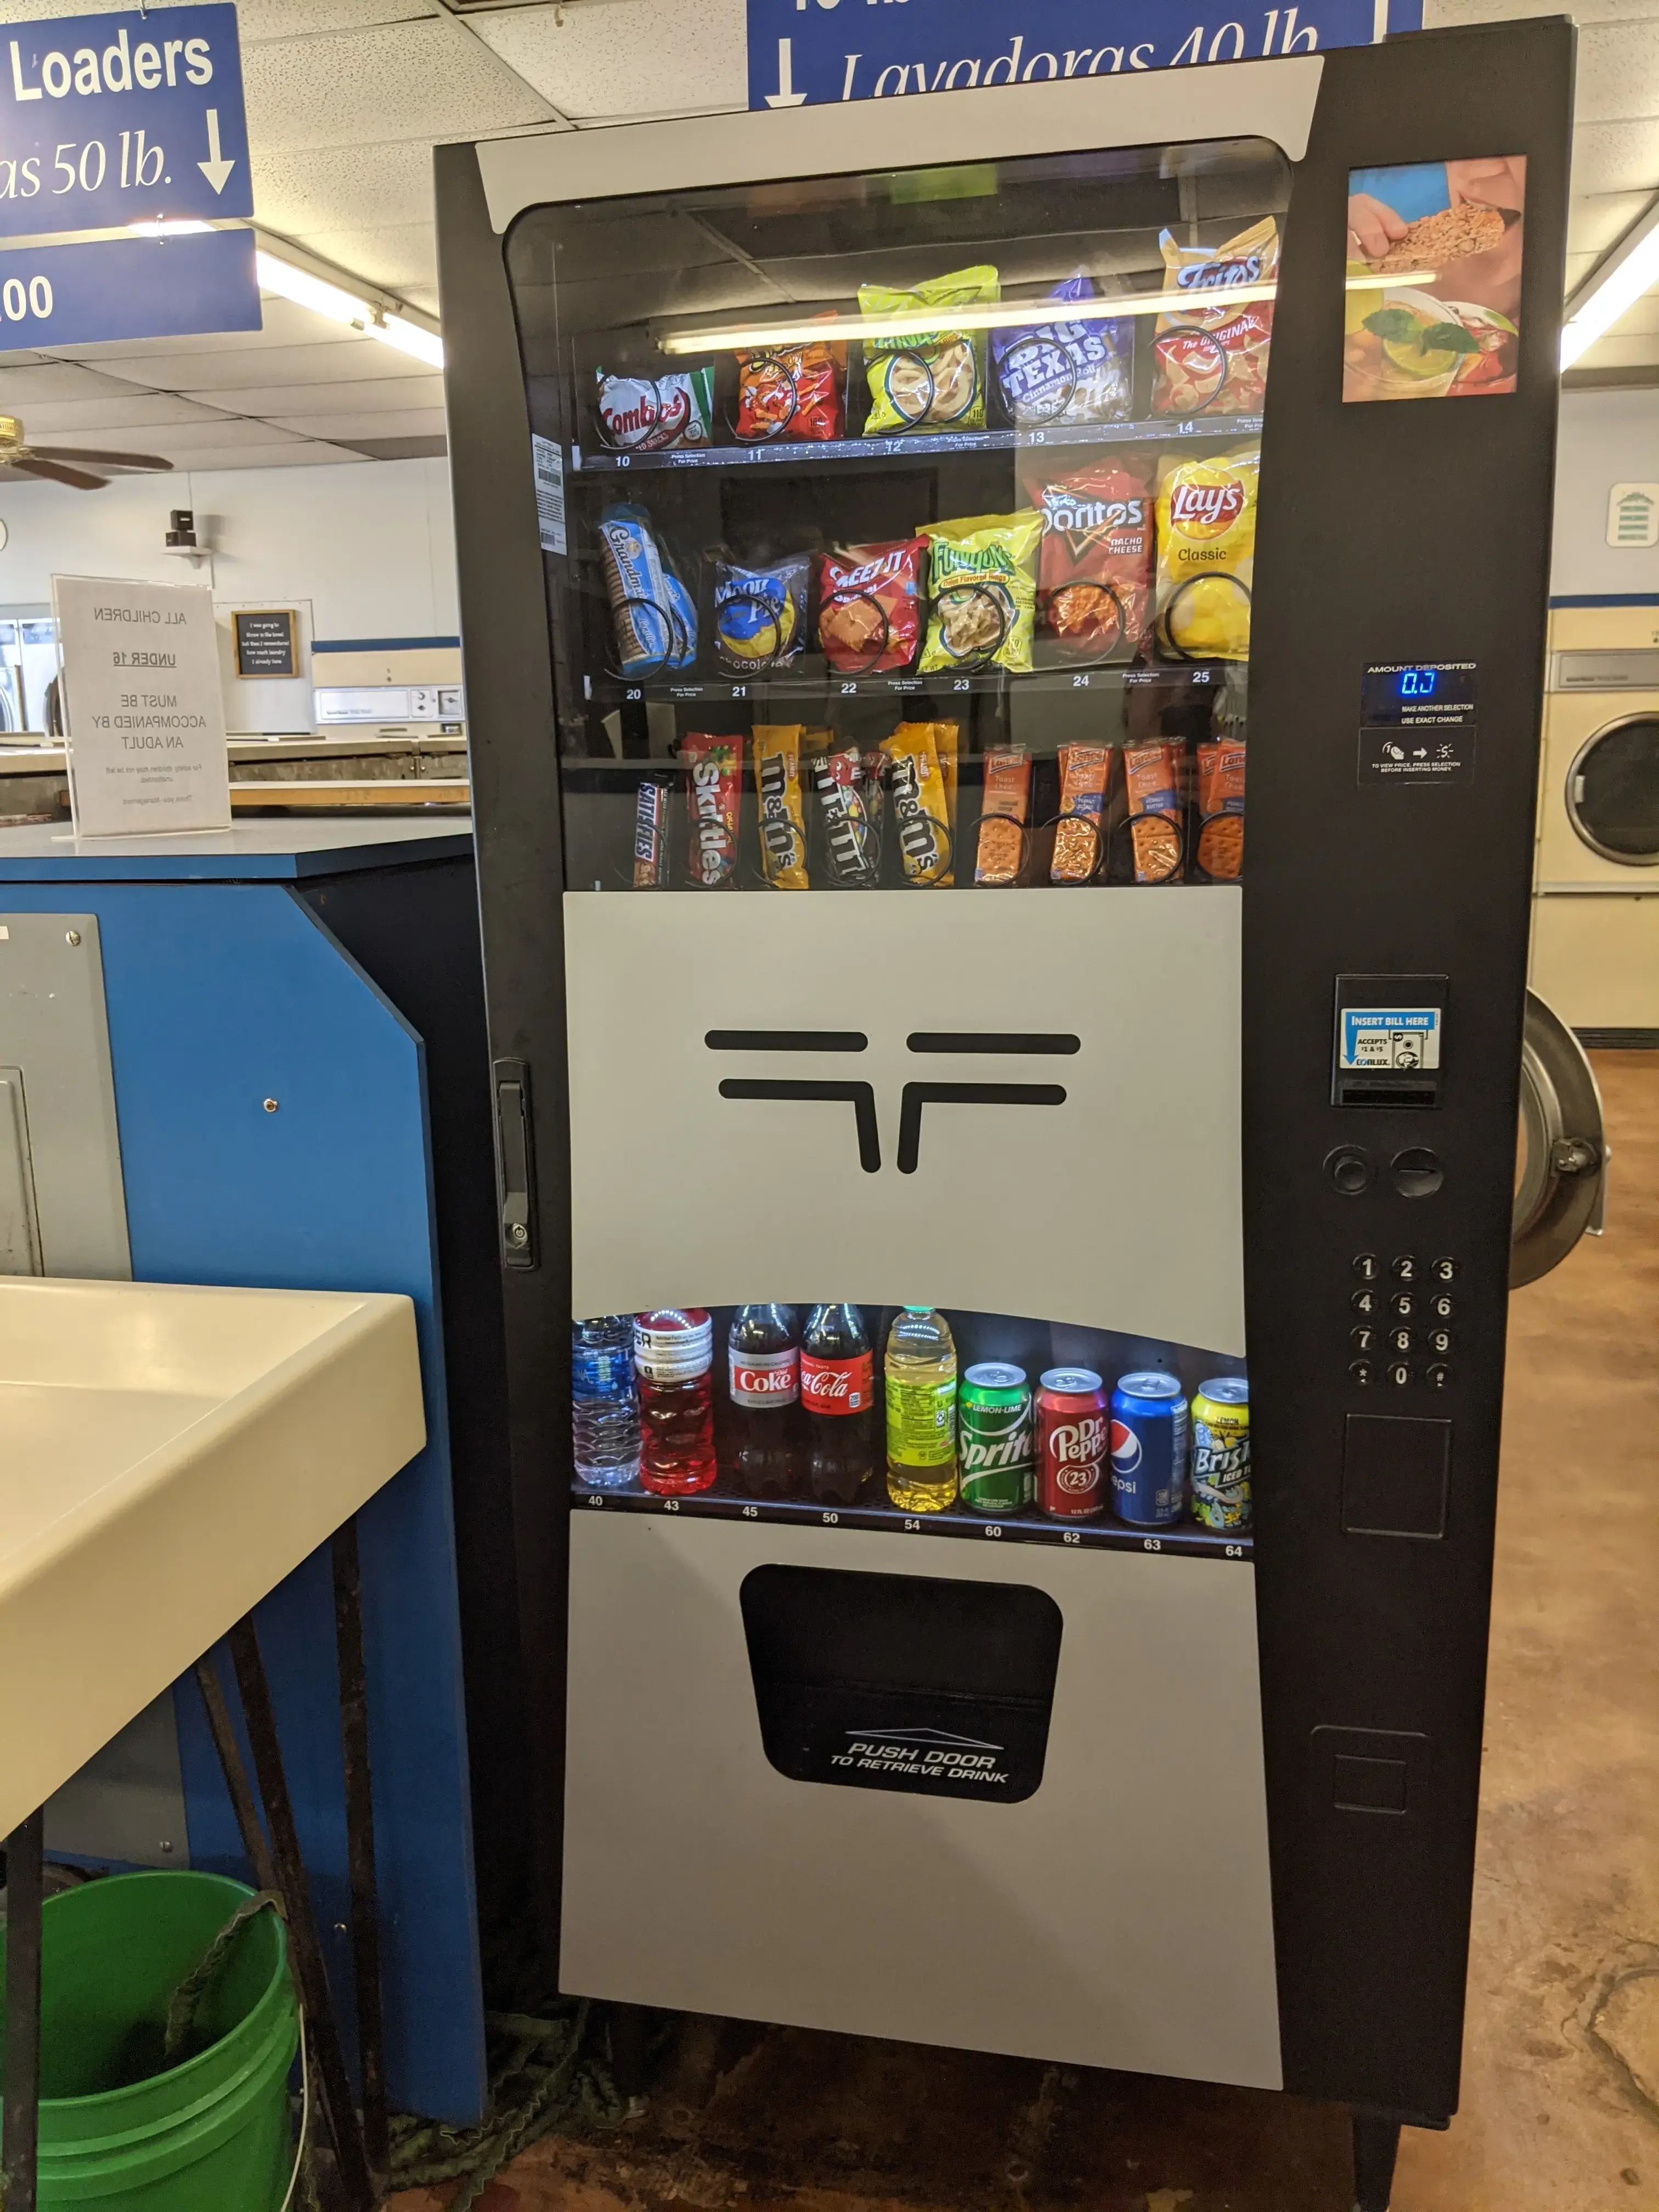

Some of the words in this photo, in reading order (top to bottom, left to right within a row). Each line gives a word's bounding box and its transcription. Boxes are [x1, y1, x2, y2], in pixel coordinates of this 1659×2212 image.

[10, 29, 214, 101] Loaders
[52, 140, 105, 194] 50
[120, 130, 171, 189] lb.
[1177, 256, 1260, 290] Fritos
[1183, 341, 1198, 349] The
[1002, 336, 1105, 398] TEXAS
[1022, 374, 1073, 403] Cinnamon
[1076, 365, 1095, 378] Roll
[1178, 421, 1193, 435] 14
[1029, 431, 1045, 443] 13
[886, 441, 901, 452] 12
[616, 455, 630, 467] 10
[748, 450, 762, 461] 11
[1172, 483, 1241, 524] Lay's
[1111, 537, 1142, 546] NACHO
[1109, 545, 1142, 554] CHEESE
[1178, 547, 1227, 562] Classic
[960, 573, 987, 583] Flavored
[988, 573, 1006, 582] Rings
[1367, 664, 1414, 674] AMOUNT
[1415, 663, 1477, 672] DEPOSITED
[1073, 675, 1090, 687] 24
[1192, 671, 1210, 683] 25
[841, 683, 857, 694] 22
[953, 679, 970, 691] 23
[627, 689, 641, 700] 20
[732, 686, 746, 697] 21
[1137, 773, 1158, 782] Toast
[636, 783, 657, 861] SATISFIES
[692, 763, 727, 885] Skittles
[1351, 1015, 1384, 1026] INSERT
[1385, 1017, 1404, 1026] BILL
[1405, 1017, 1429, 1026] HERE
[1363, 1259, 1372, 1276] 1
[1401, 1260, 1413, 1278] 2
[1440, 1262, 1453, 1279] 3
[1359, 1295, 1371, 1312] 4
[1399, 1297, 1411, 1314] 5
[1437, 1297, 1451, 1316] 6
[1359, 1331, 1370, 1348] 7
[1398, 1331, 1409, 1349] 8
[1436, 1334, 1448, 1351] 9
[739, 1370, 792, 1392] Coke
[1396, 1367, 1407, 1385] 0
[972, 1403, 1022, 1414] LEMON-LIME
[1216, 1416, 1239, 1425] LEMON
[1078, 1416, 1104, 1443] Dr
[1069, 1471, 1087, 1487] 23
[1223, 1468, 1243, 1482] ICED
[588, 1496, 603, 1506] 40
[664, 1500, 680, 1511] 43
[742, 1506, 758, 1517] 45
[822, 1513, 839, 1523] 50
[904, 1519, 921, 1530] 54
[985, 1526, 1002, 1537] 60
[1063, 1532, 1081, 1544] 62
[1144, 1539, 1161, 1551] 63
[1225, 1545, 1243, 1557] 64
[847, 1742, 920, 1761] PUSH
[923, 1750, 996, 1769] DOOR
[831, 1755, 854, 1765] TO
[856, 1757, 945, 1777] RETRIEVE
[947, 1767, 1009, 1783] DRINK
